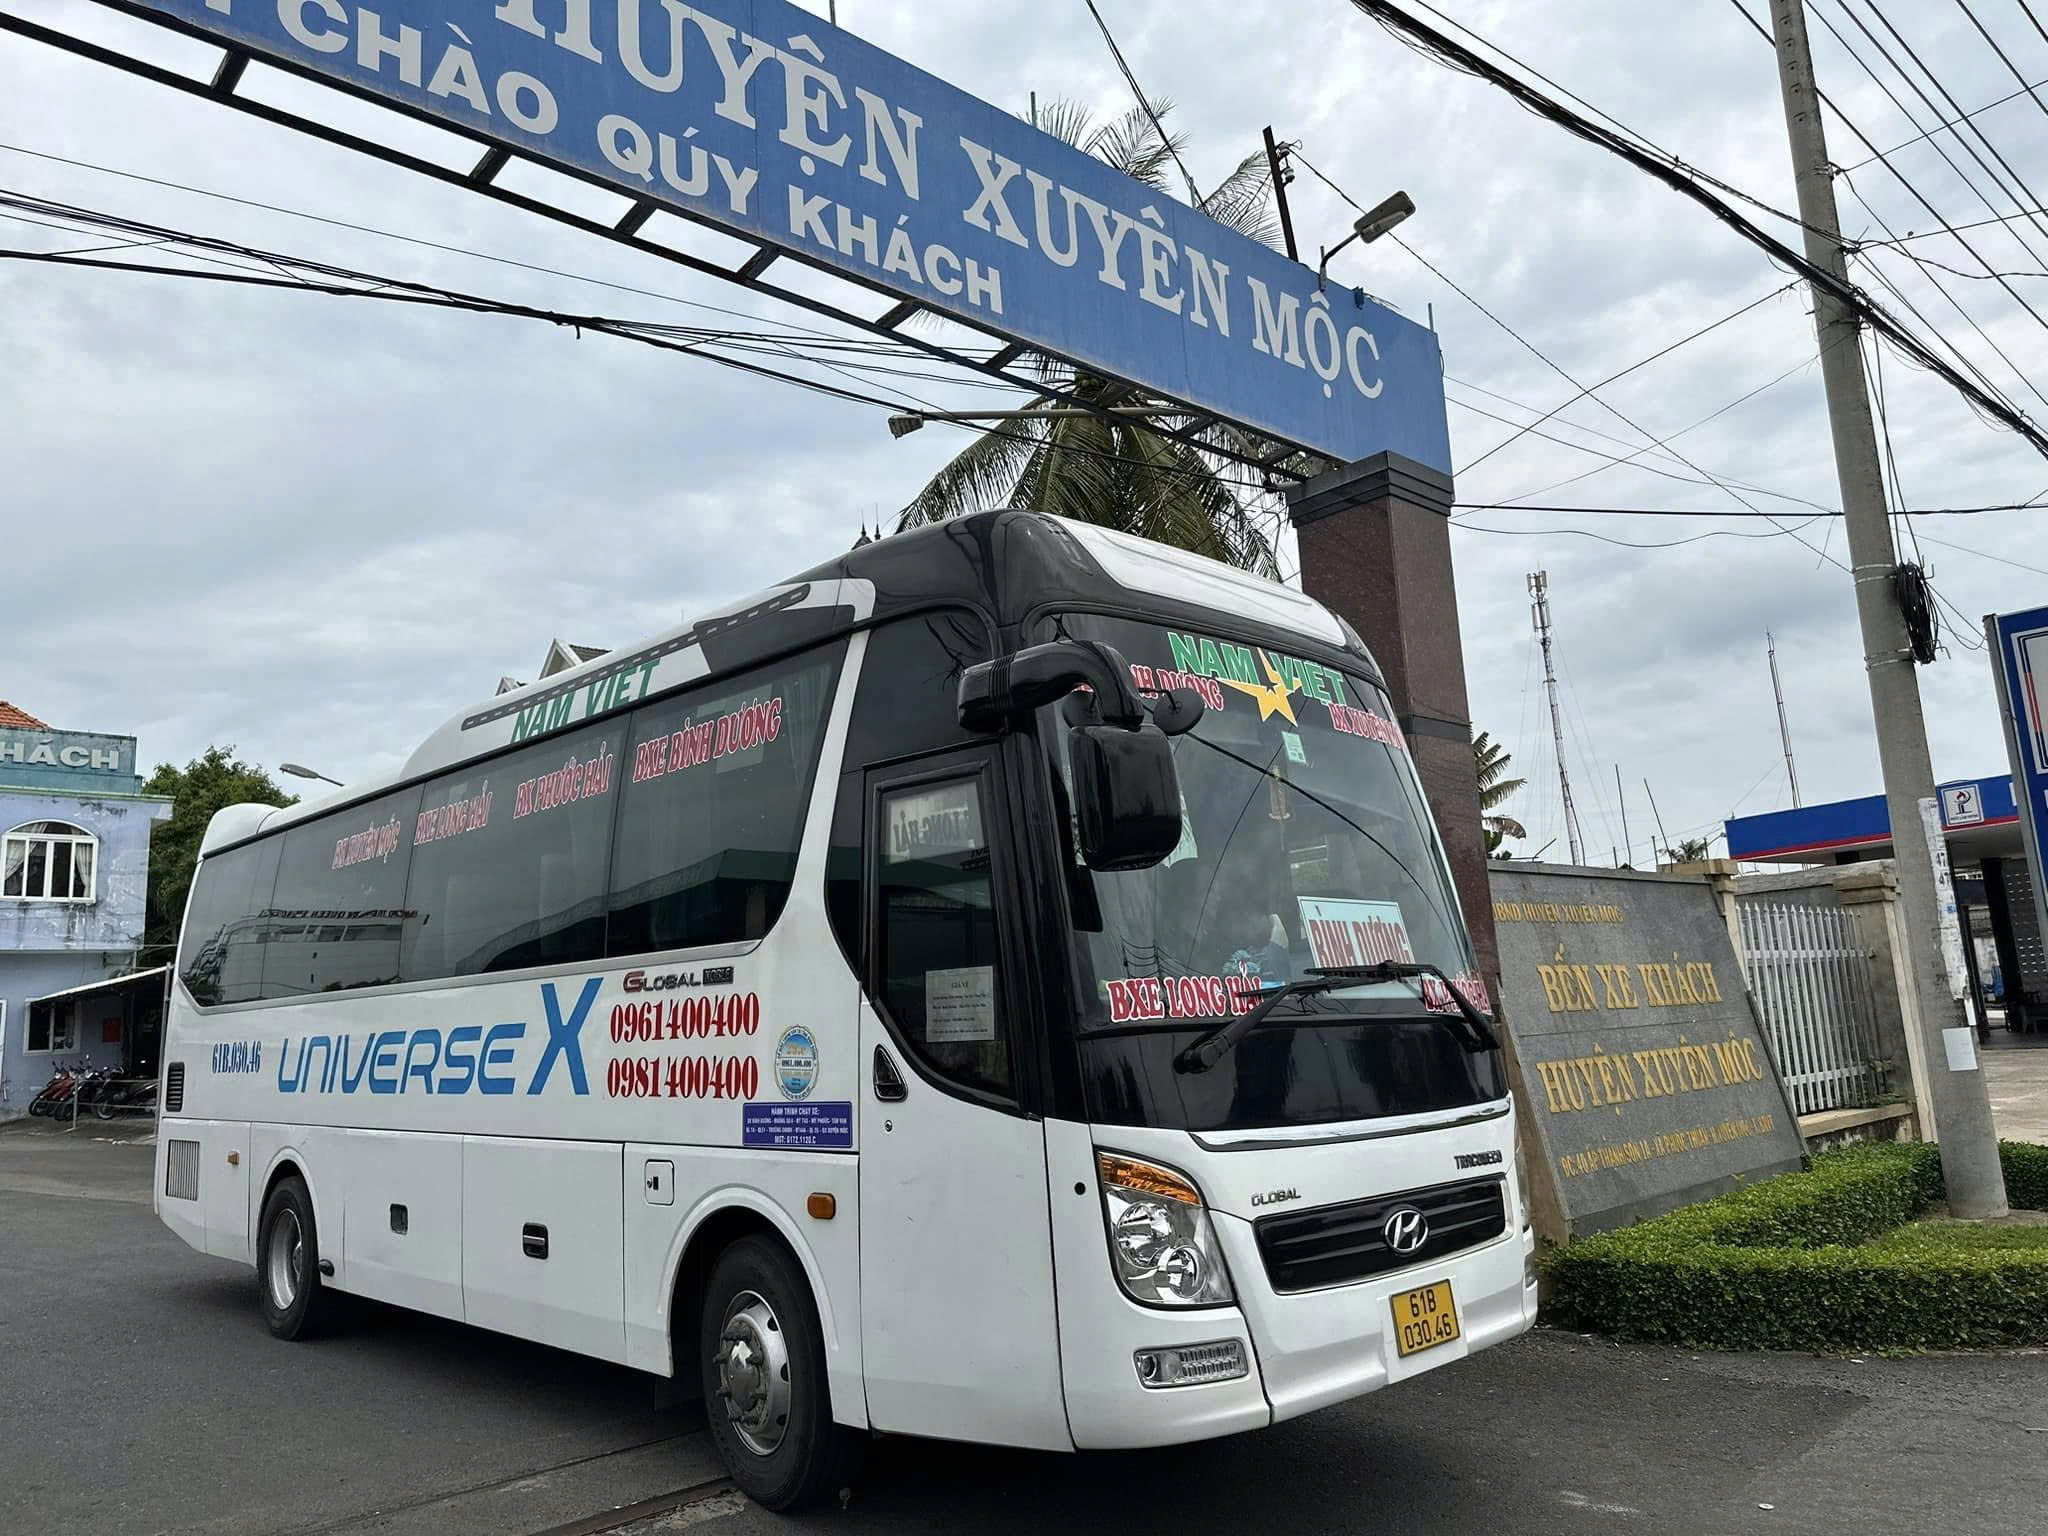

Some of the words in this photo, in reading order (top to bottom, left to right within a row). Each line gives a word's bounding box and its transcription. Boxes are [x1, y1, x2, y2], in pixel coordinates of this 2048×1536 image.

[277, 0, 558, 134] CHÀO
[596, 114, 760, 215] QÚY
[789, 184, 1004, 315] KHÁCH
[959, 135, 1230, 337] XUYÊN
[1247, 288, 1383, 399] MỘC
[1167, 631, 1260, 687] NAM
[1269, 651, 1348, 707] VIỆT
[511, 689, 576, 745] NAM
[633, 736, 669, 784] BXE
[713, 697, 782, 760] DƯƠNG
[0, 738, 119, 770] HÁCH
[581, 741, 613, 798] HẢI
[623, 970, 702, 993] GLOBAL
[1107, 977, 1165, 1023] BXE
[1163, 976, 1226, 1018] LONG
[1536, 943, 1600, 1013] BẾN
[1595, 963, 1640, 1010] XE
[1636, 951, 1722, 1008] KHÁCH
[278, 1022, 527, 1096] UNIVERSE
[526, 976, 604, 1096] X
[1536, 1042, 1639, 1117] HUYỆN
[1632, 1033, 1719, 1098] XUYÊN
[1711, 1029, 1763, 1091] MỘC
[1251, 1187, 1302, 1207] GLOBAL
[1404, 1312, 1453, 1349] 030.46
[1409, 1288, 1437, 1318] 61B
